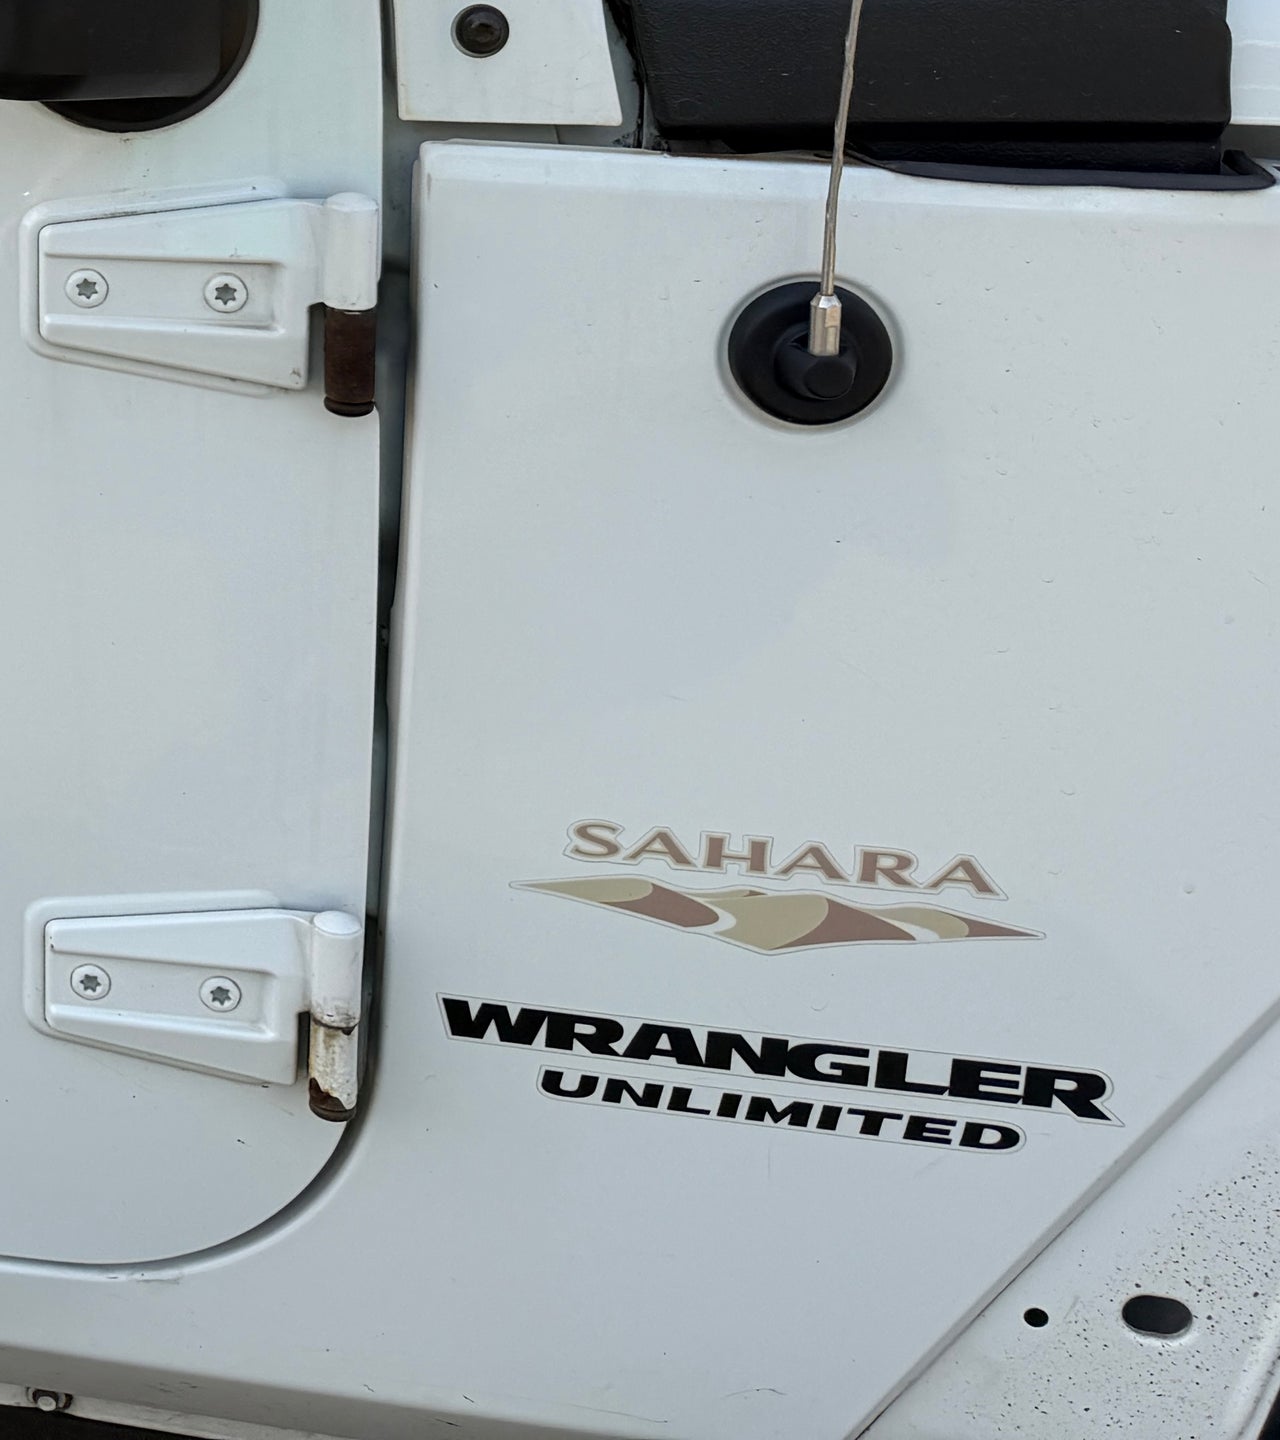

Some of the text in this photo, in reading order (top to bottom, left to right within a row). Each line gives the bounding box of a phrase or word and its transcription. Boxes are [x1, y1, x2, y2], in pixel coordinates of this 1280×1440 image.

[572, 821, 1002, 897] SAHARA
[442, 997, 1112, 1122] WRANGLER
[541, 1069, 1021, 1150] UNLIMITED
